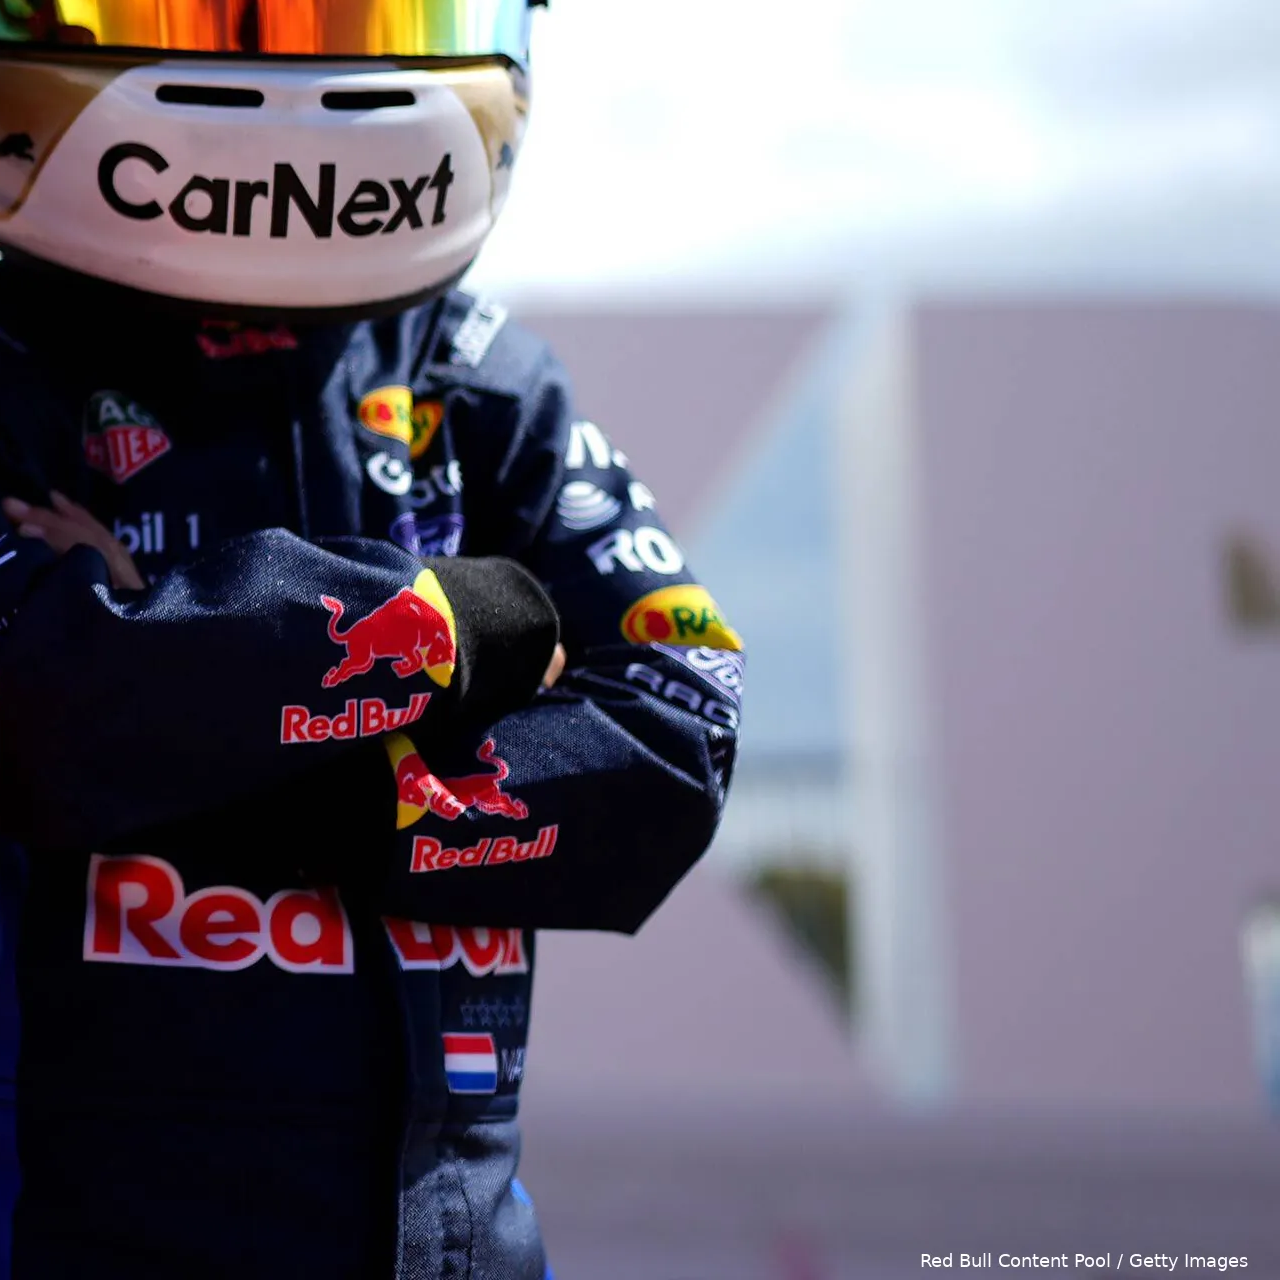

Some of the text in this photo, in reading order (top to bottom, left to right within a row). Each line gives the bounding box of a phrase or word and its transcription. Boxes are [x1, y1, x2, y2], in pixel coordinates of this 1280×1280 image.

[96, 140, 455, 240] CarNext
[185, 513, 200, 550] 1
[280, 691, 433, 745] Red Bull
[409, 824, 559, 873] Red Bull
